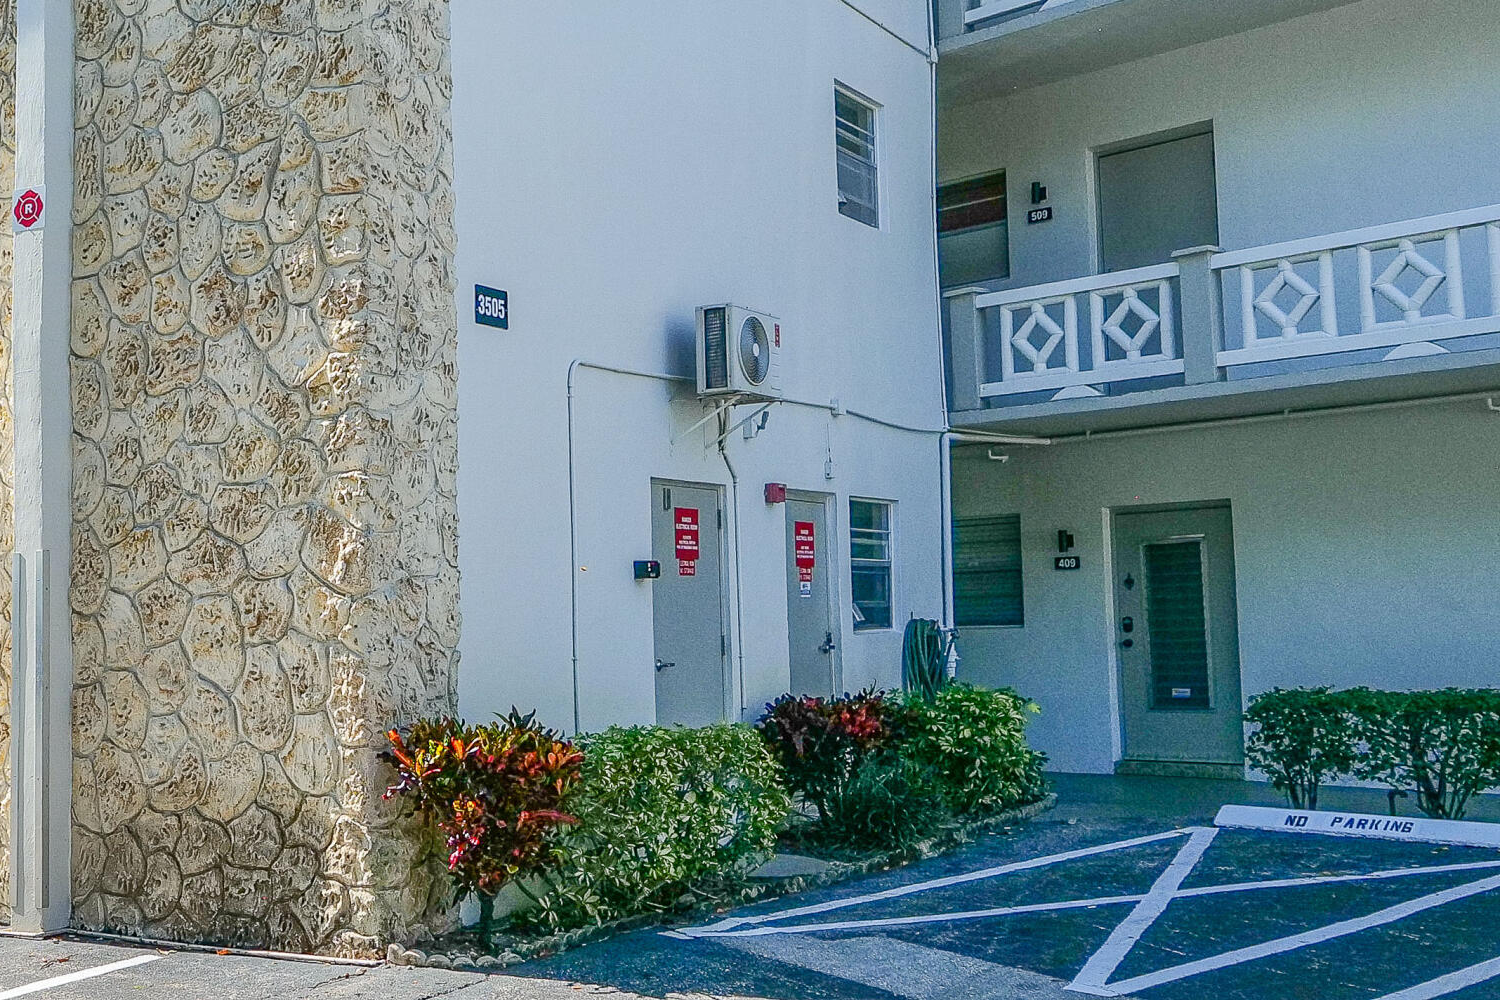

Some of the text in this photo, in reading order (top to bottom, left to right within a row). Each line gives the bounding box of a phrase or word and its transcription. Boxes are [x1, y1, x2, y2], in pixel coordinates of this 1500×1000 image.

[24, 203, 34, 215] R
[1031, 209, 1048, 221] 509
[477, 294, 506, 319] 3505
[1058, 558, 1076, 568] 409
[1284, 814, 1415, 833] NO PARKING
